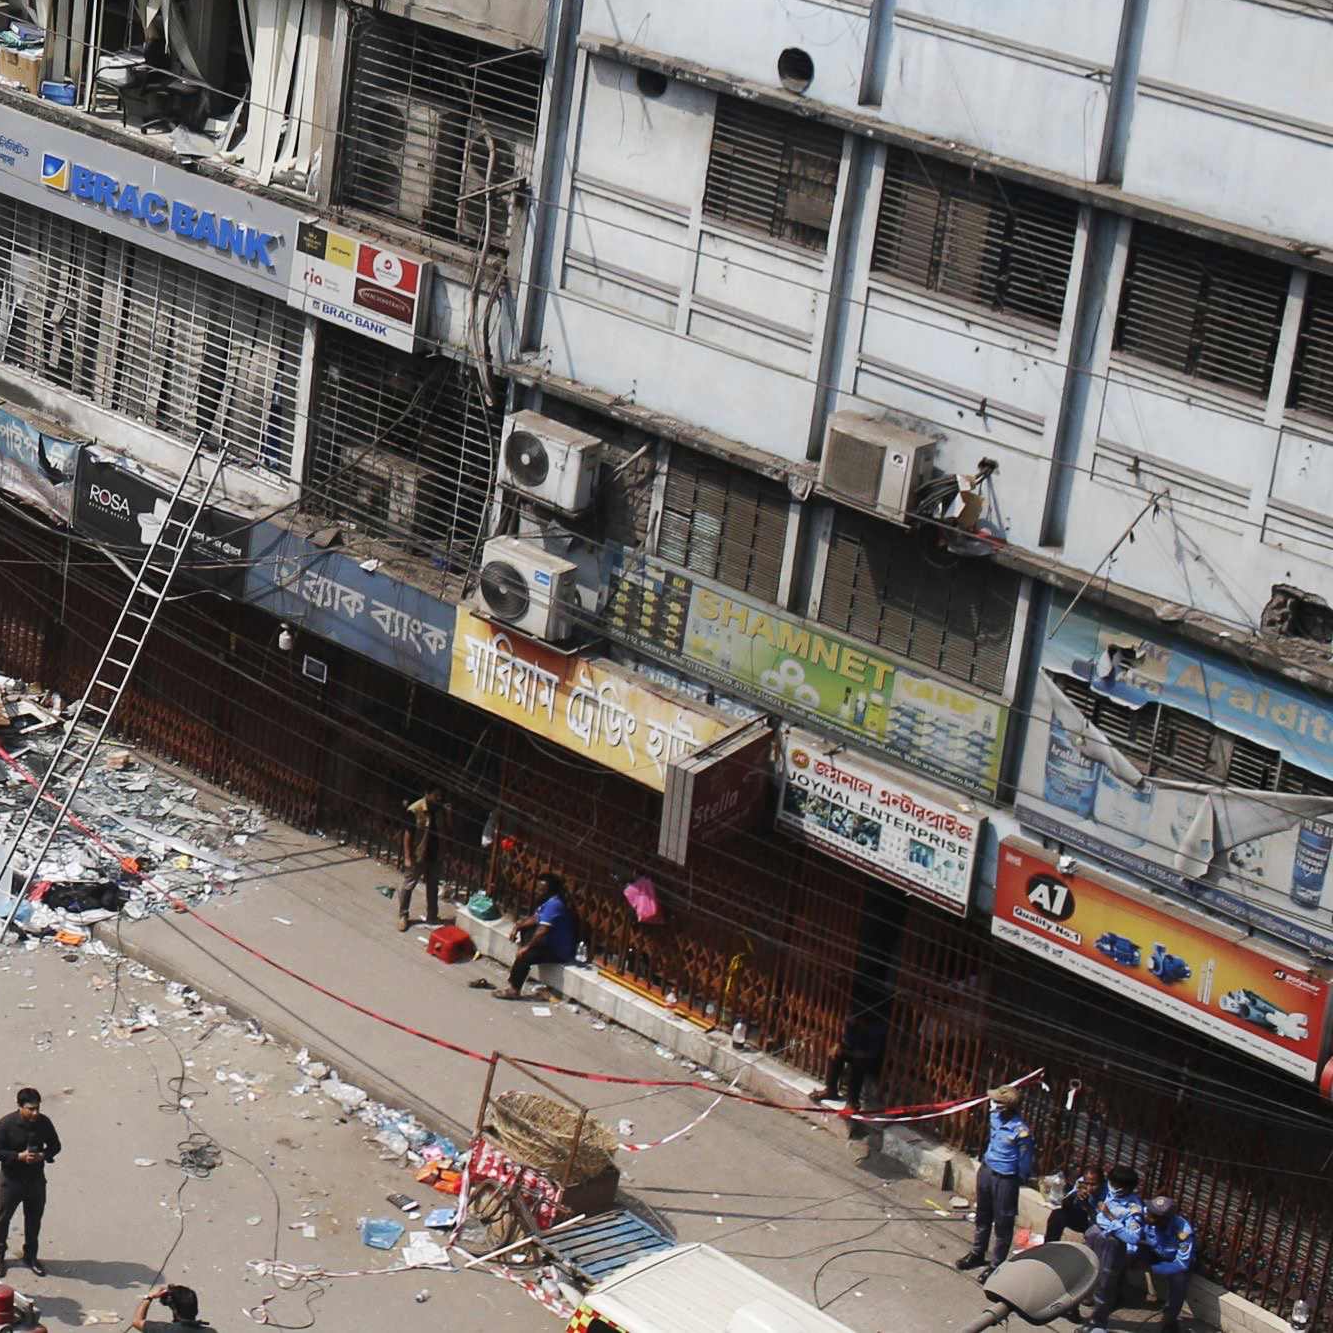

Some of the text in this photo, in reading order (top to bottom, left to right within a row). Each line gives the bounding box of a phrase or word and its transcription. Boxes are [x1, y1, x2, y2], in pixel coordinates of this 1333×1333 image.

[70, 163, 277, 266] BRAC BANK
[303, 268, 323, 286] ria
[322, 303, 388, 337] BRAC BANK
[90, 484, 131, 516] ROSA
[371, 599, 448, 656] ব্যাংক
[695, 587, 895, 691] SHAMNET
[566, 669, 638, 767] ট্রেডিং
[787, 770, 854, 809] JOYNAL
[859, 801, 969, 859] ENTERPRISE
[813, 758, 873, 799] জয়নাল
[878, 785, 973, 842] এন্টারপ্রাইজ
[1028, 882, 1069, 916] A1
[1014, 907, 1054, 933] Quality
[1055, 924, 1081, 944] No.1
[1285, 975, 1321, 992] polymer
